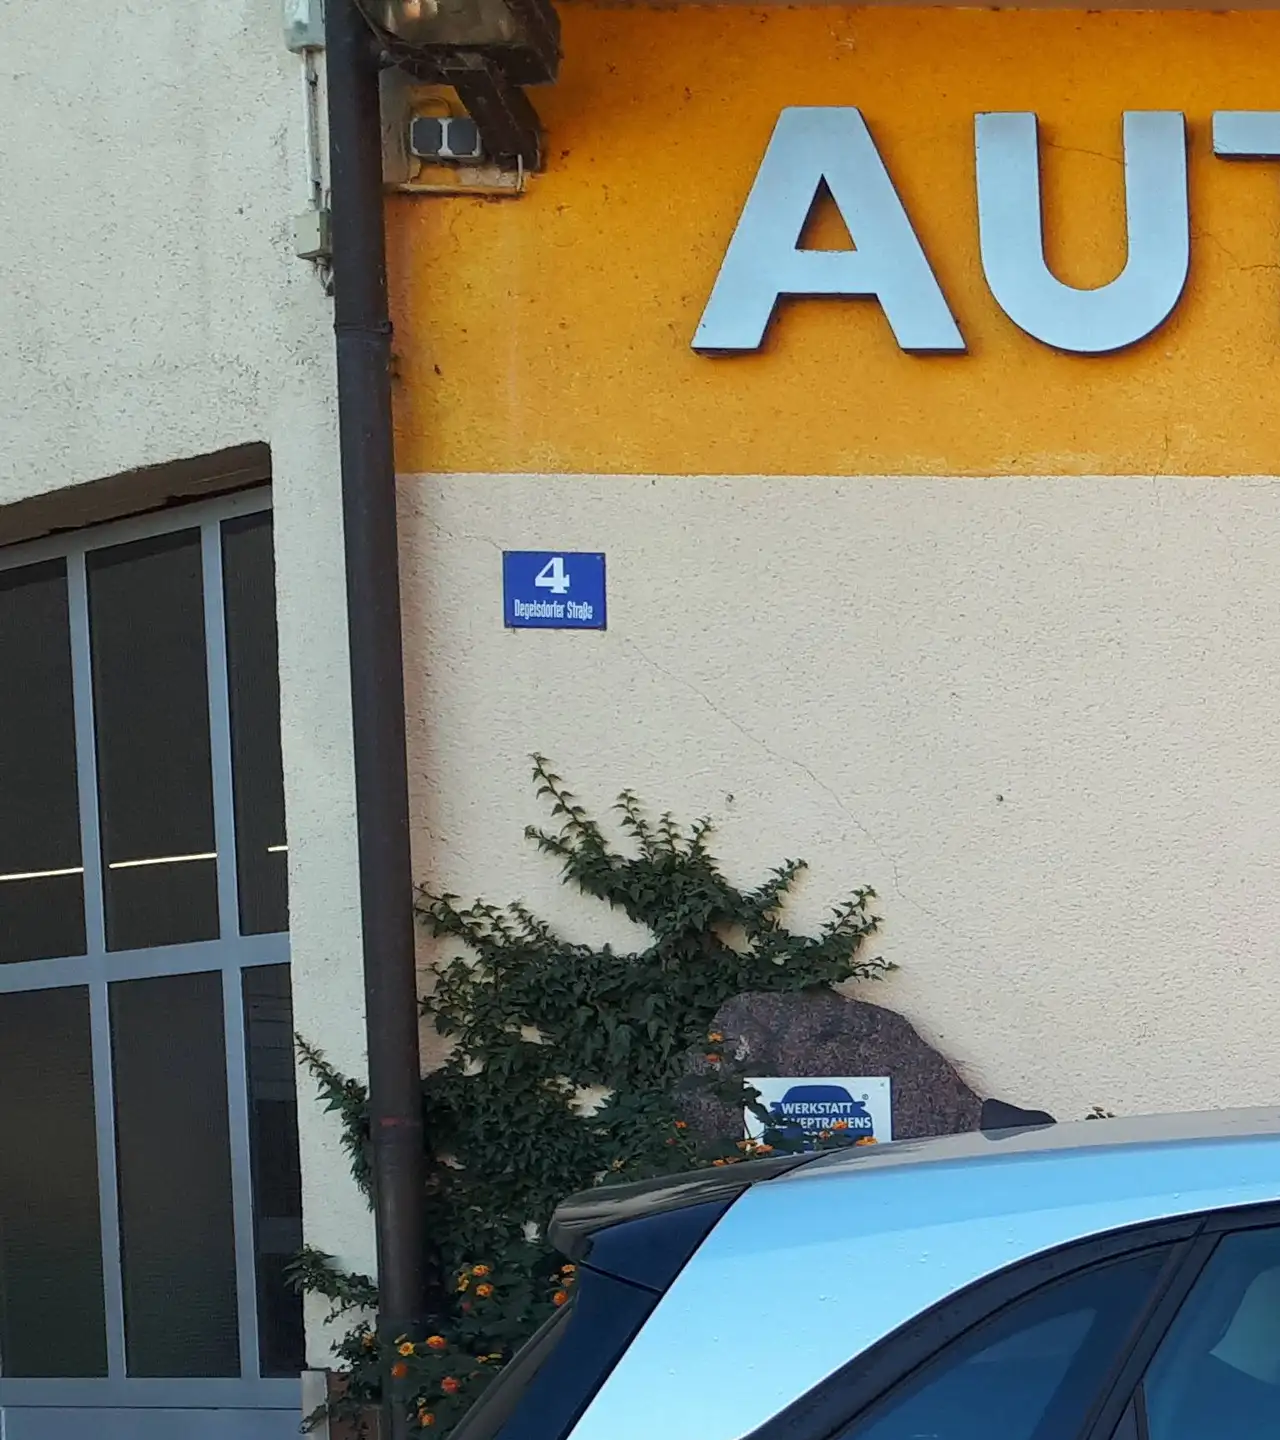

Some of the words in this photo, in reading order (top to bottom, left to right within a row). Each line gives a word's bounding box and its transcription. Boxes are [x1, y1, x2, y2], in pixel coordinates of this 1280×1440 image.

[534, 556, 571, 594] 4
[566, 600, 594, 621] Straße
[781, 1102, 852, 1114] WERKSTATT
